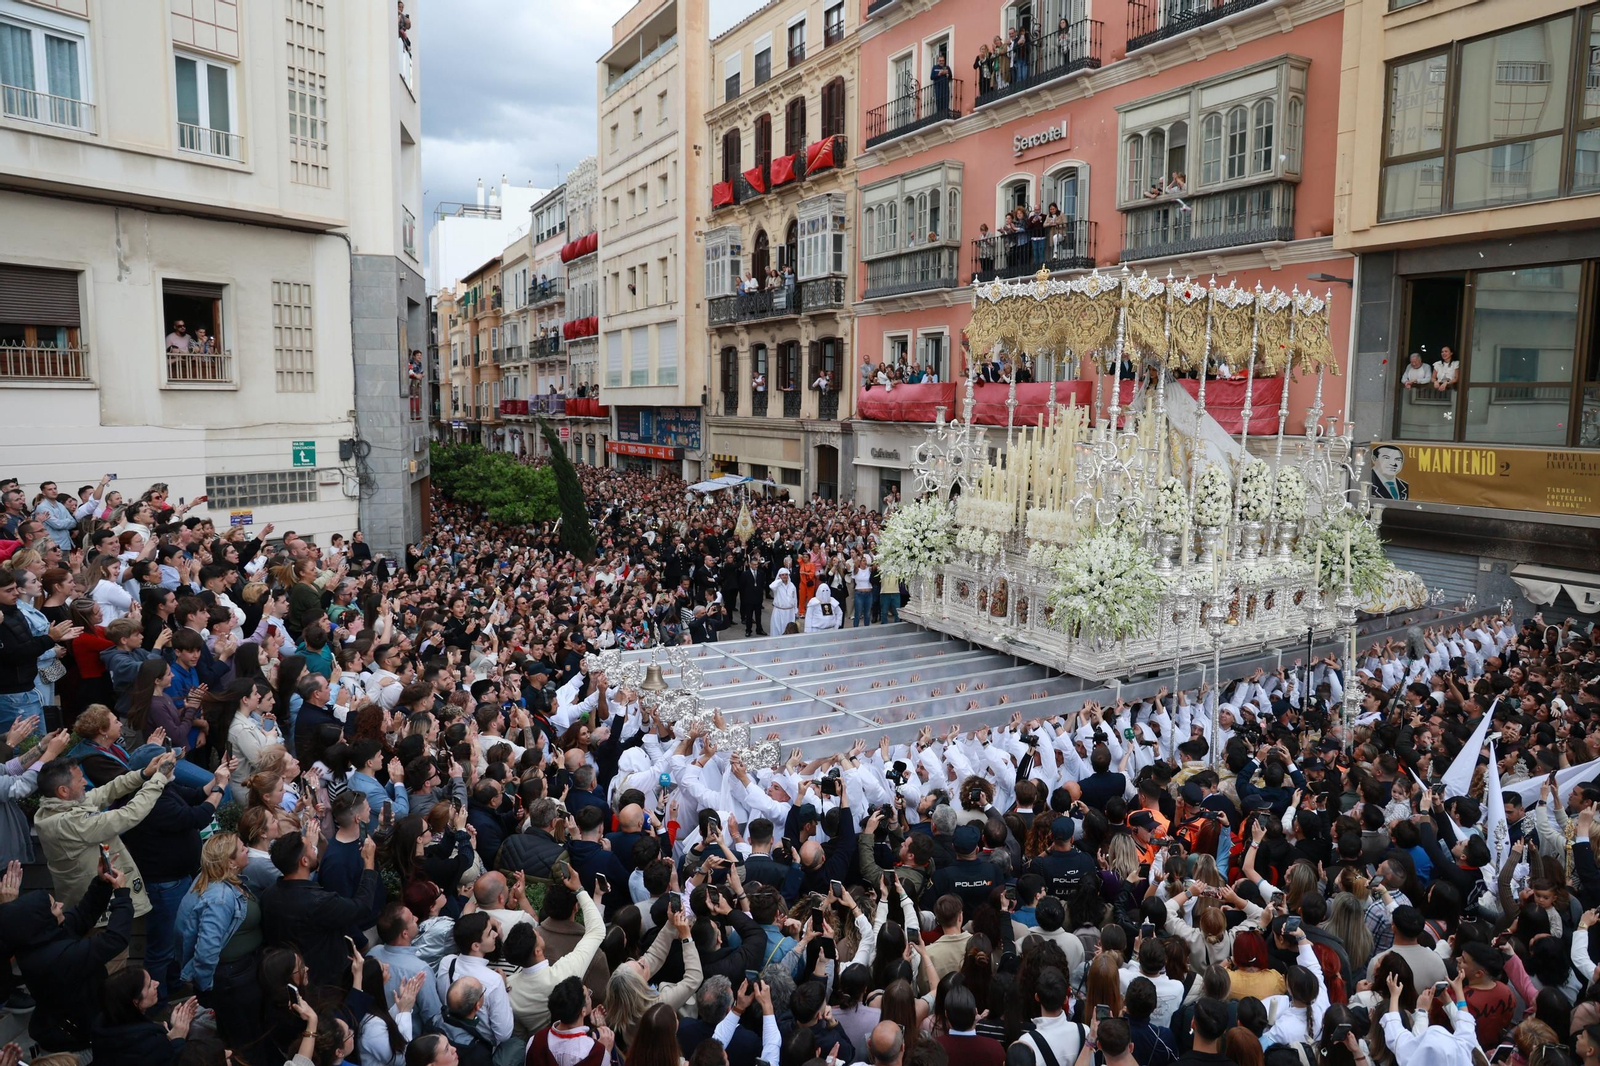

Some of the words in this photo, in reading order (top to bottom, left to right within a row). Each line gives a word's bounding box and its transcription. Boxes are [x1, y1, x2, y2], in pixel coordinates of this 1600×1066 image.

[1013, 120, 1067, 151] Sercotel
[1409, 447, 1416, 459] EL
[1500, 461, 1511, 477] 2
[954, 880, 988, 888] POLICIA
